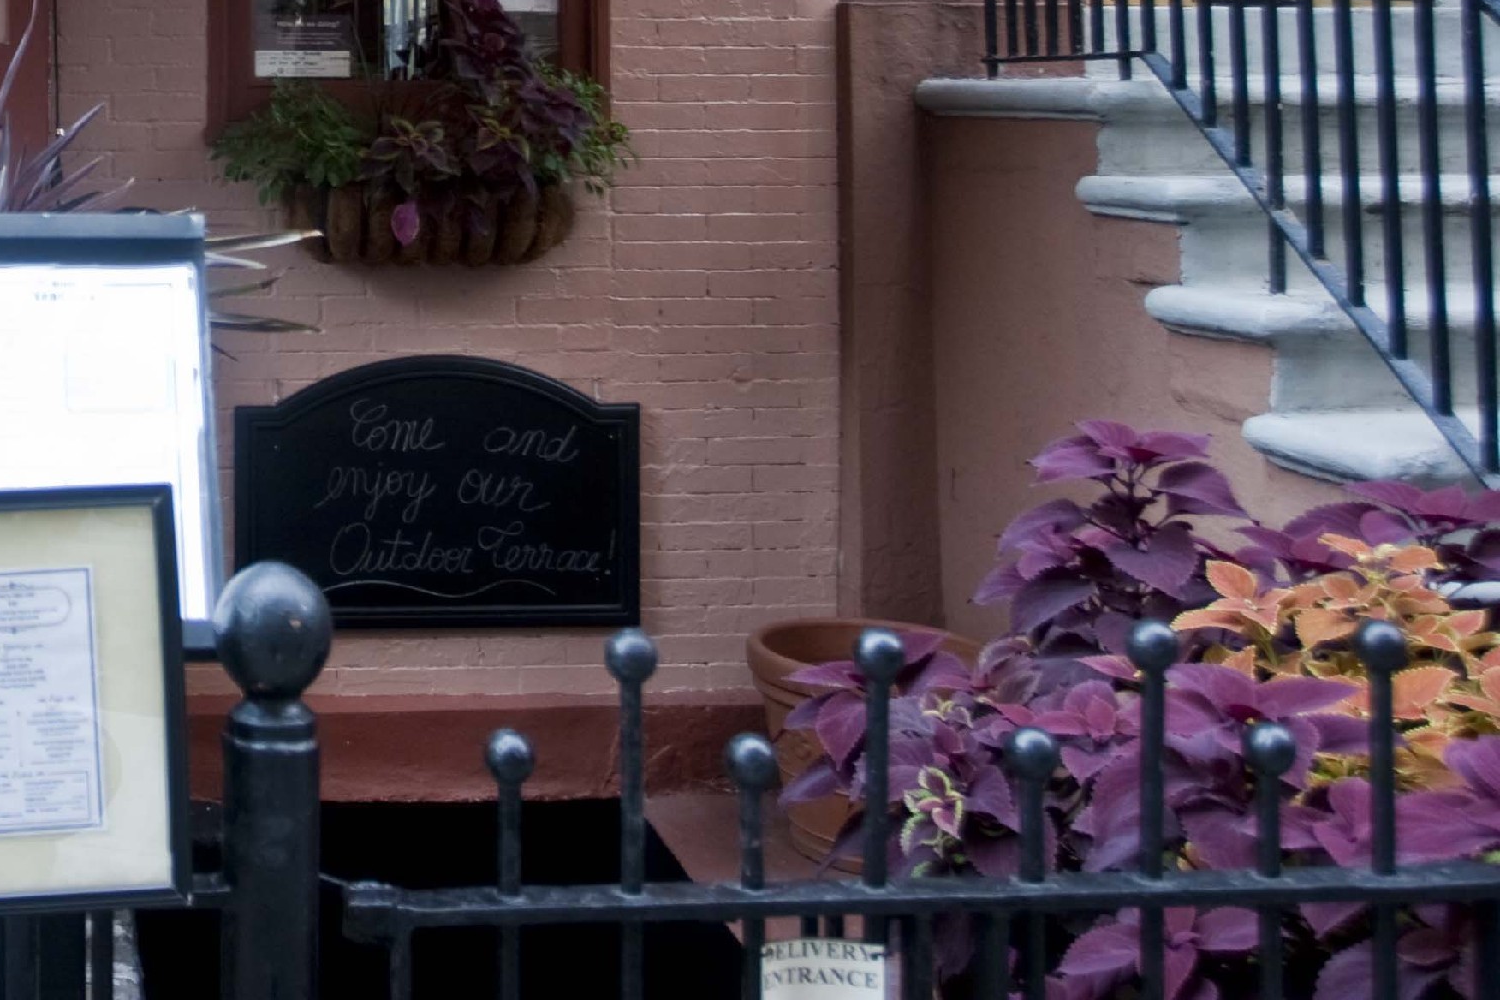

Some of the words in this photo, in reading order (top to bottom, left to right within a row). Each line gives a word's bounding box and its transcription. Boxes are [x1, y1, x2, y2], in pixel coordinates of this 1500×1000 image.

[350, 398, 446, 453] Come
[483, 424, 580, 463] and
[314, 461, 437, 523] enjoy
[329, 521, 475, 576] Outdoor
